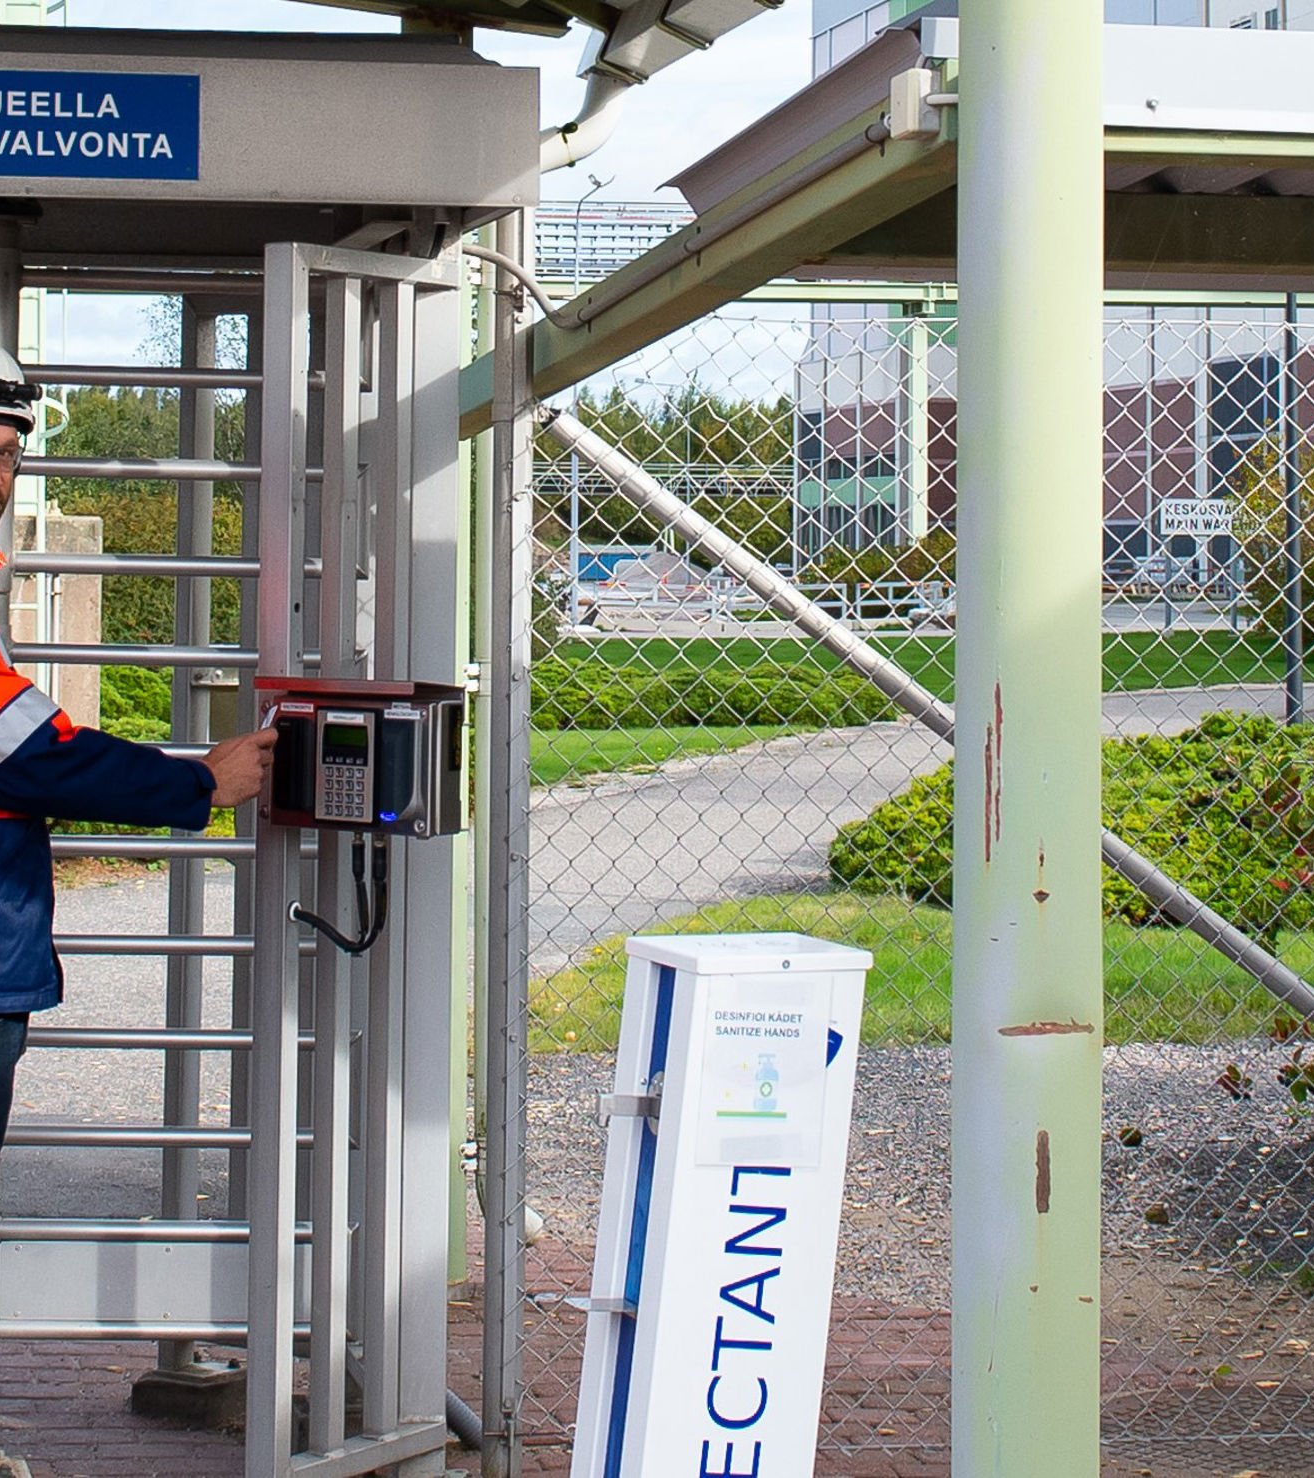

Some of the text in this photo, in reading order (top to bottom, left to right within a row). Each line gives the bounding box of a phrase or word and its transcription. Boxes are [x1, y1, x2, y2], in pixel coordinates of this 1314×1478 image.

[714, 1010, 803, 1023] DESINFIOI KÄDET
[715, 1026, 800, 1038] SANITIZE HANDS
